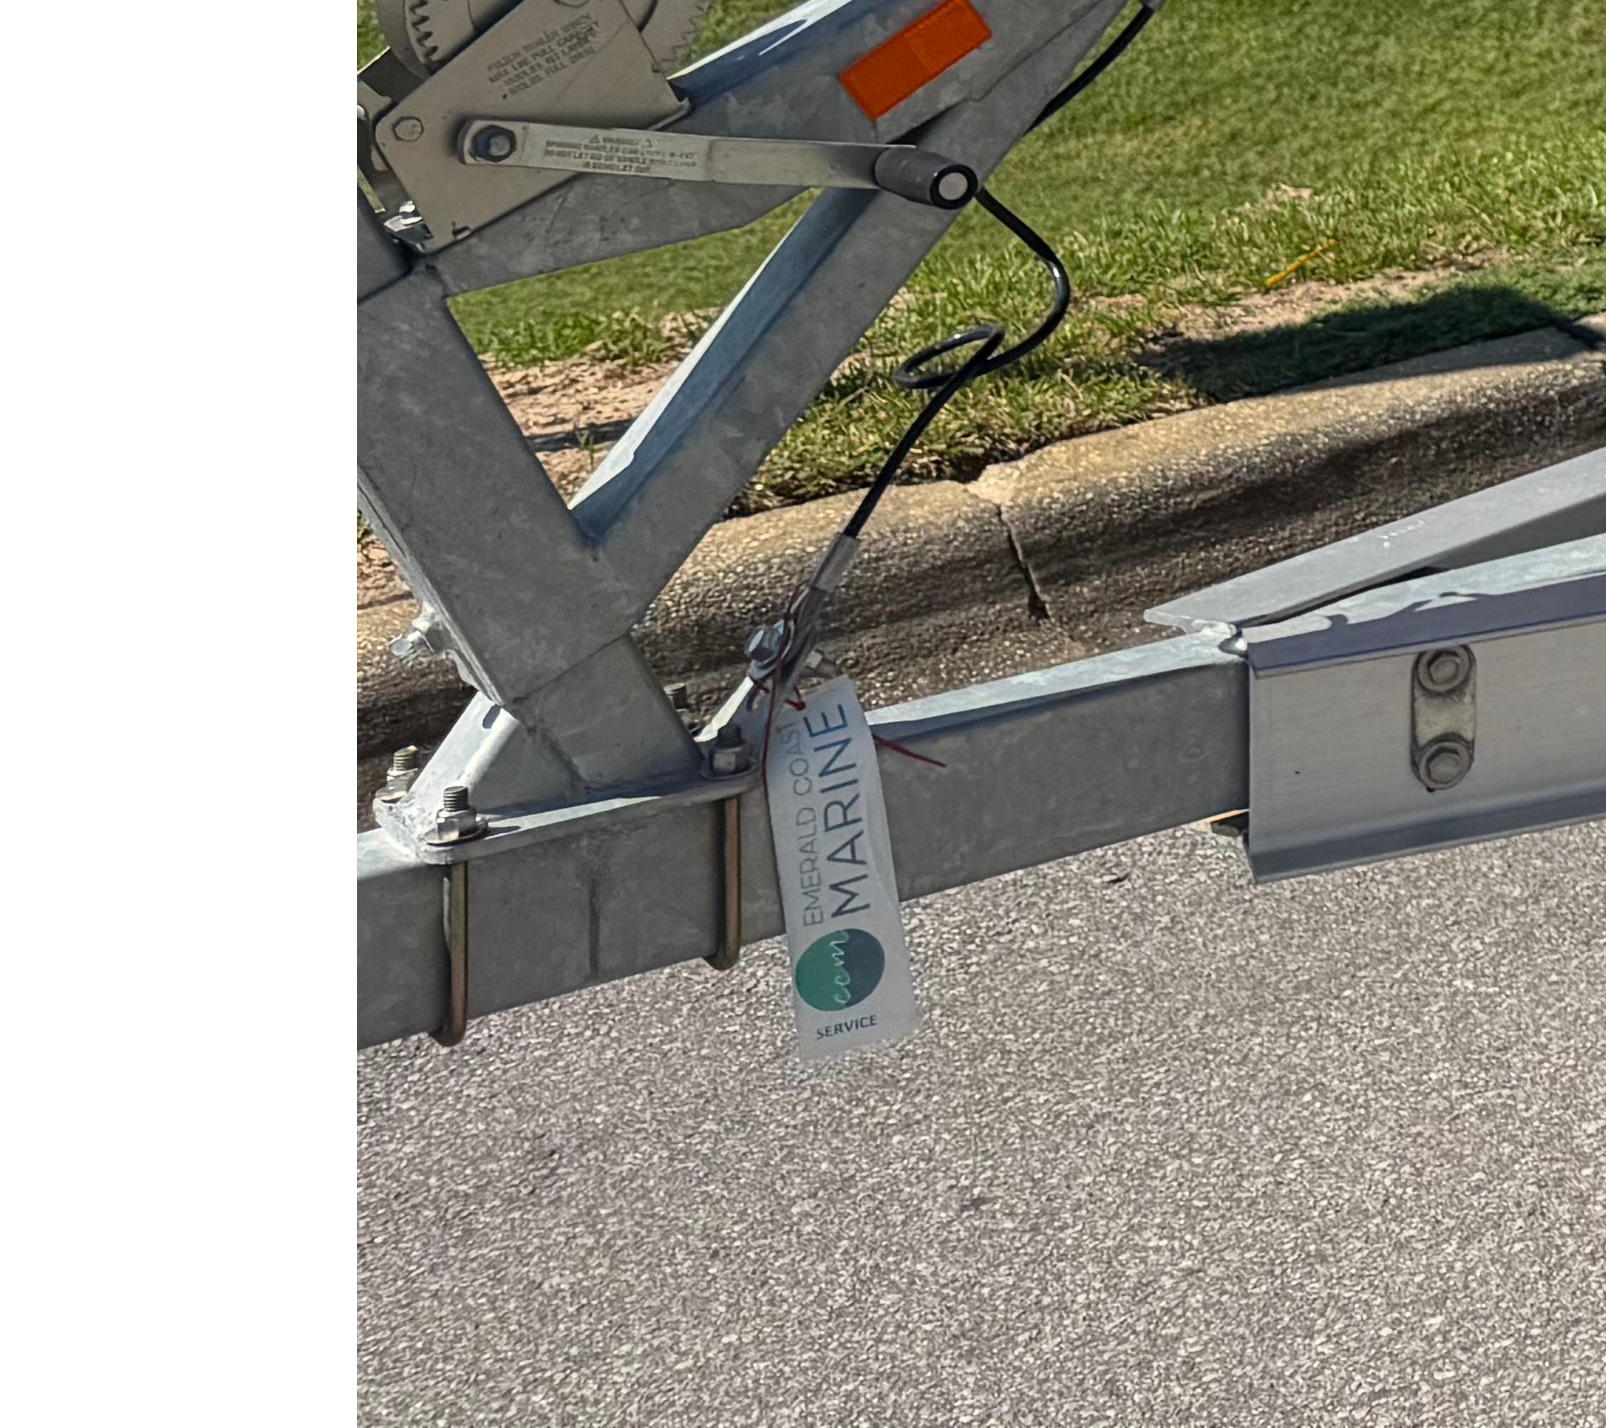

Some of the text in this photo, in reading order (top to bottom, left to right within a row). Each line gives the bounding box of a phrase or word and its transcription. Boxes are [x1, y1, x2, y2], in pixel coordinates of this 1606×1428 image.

[776, 721, 823, 926] EMERALD COAST
[804, 703, 871, 919] MARINE
[815, 1014, 878, 1041] SERVICE
